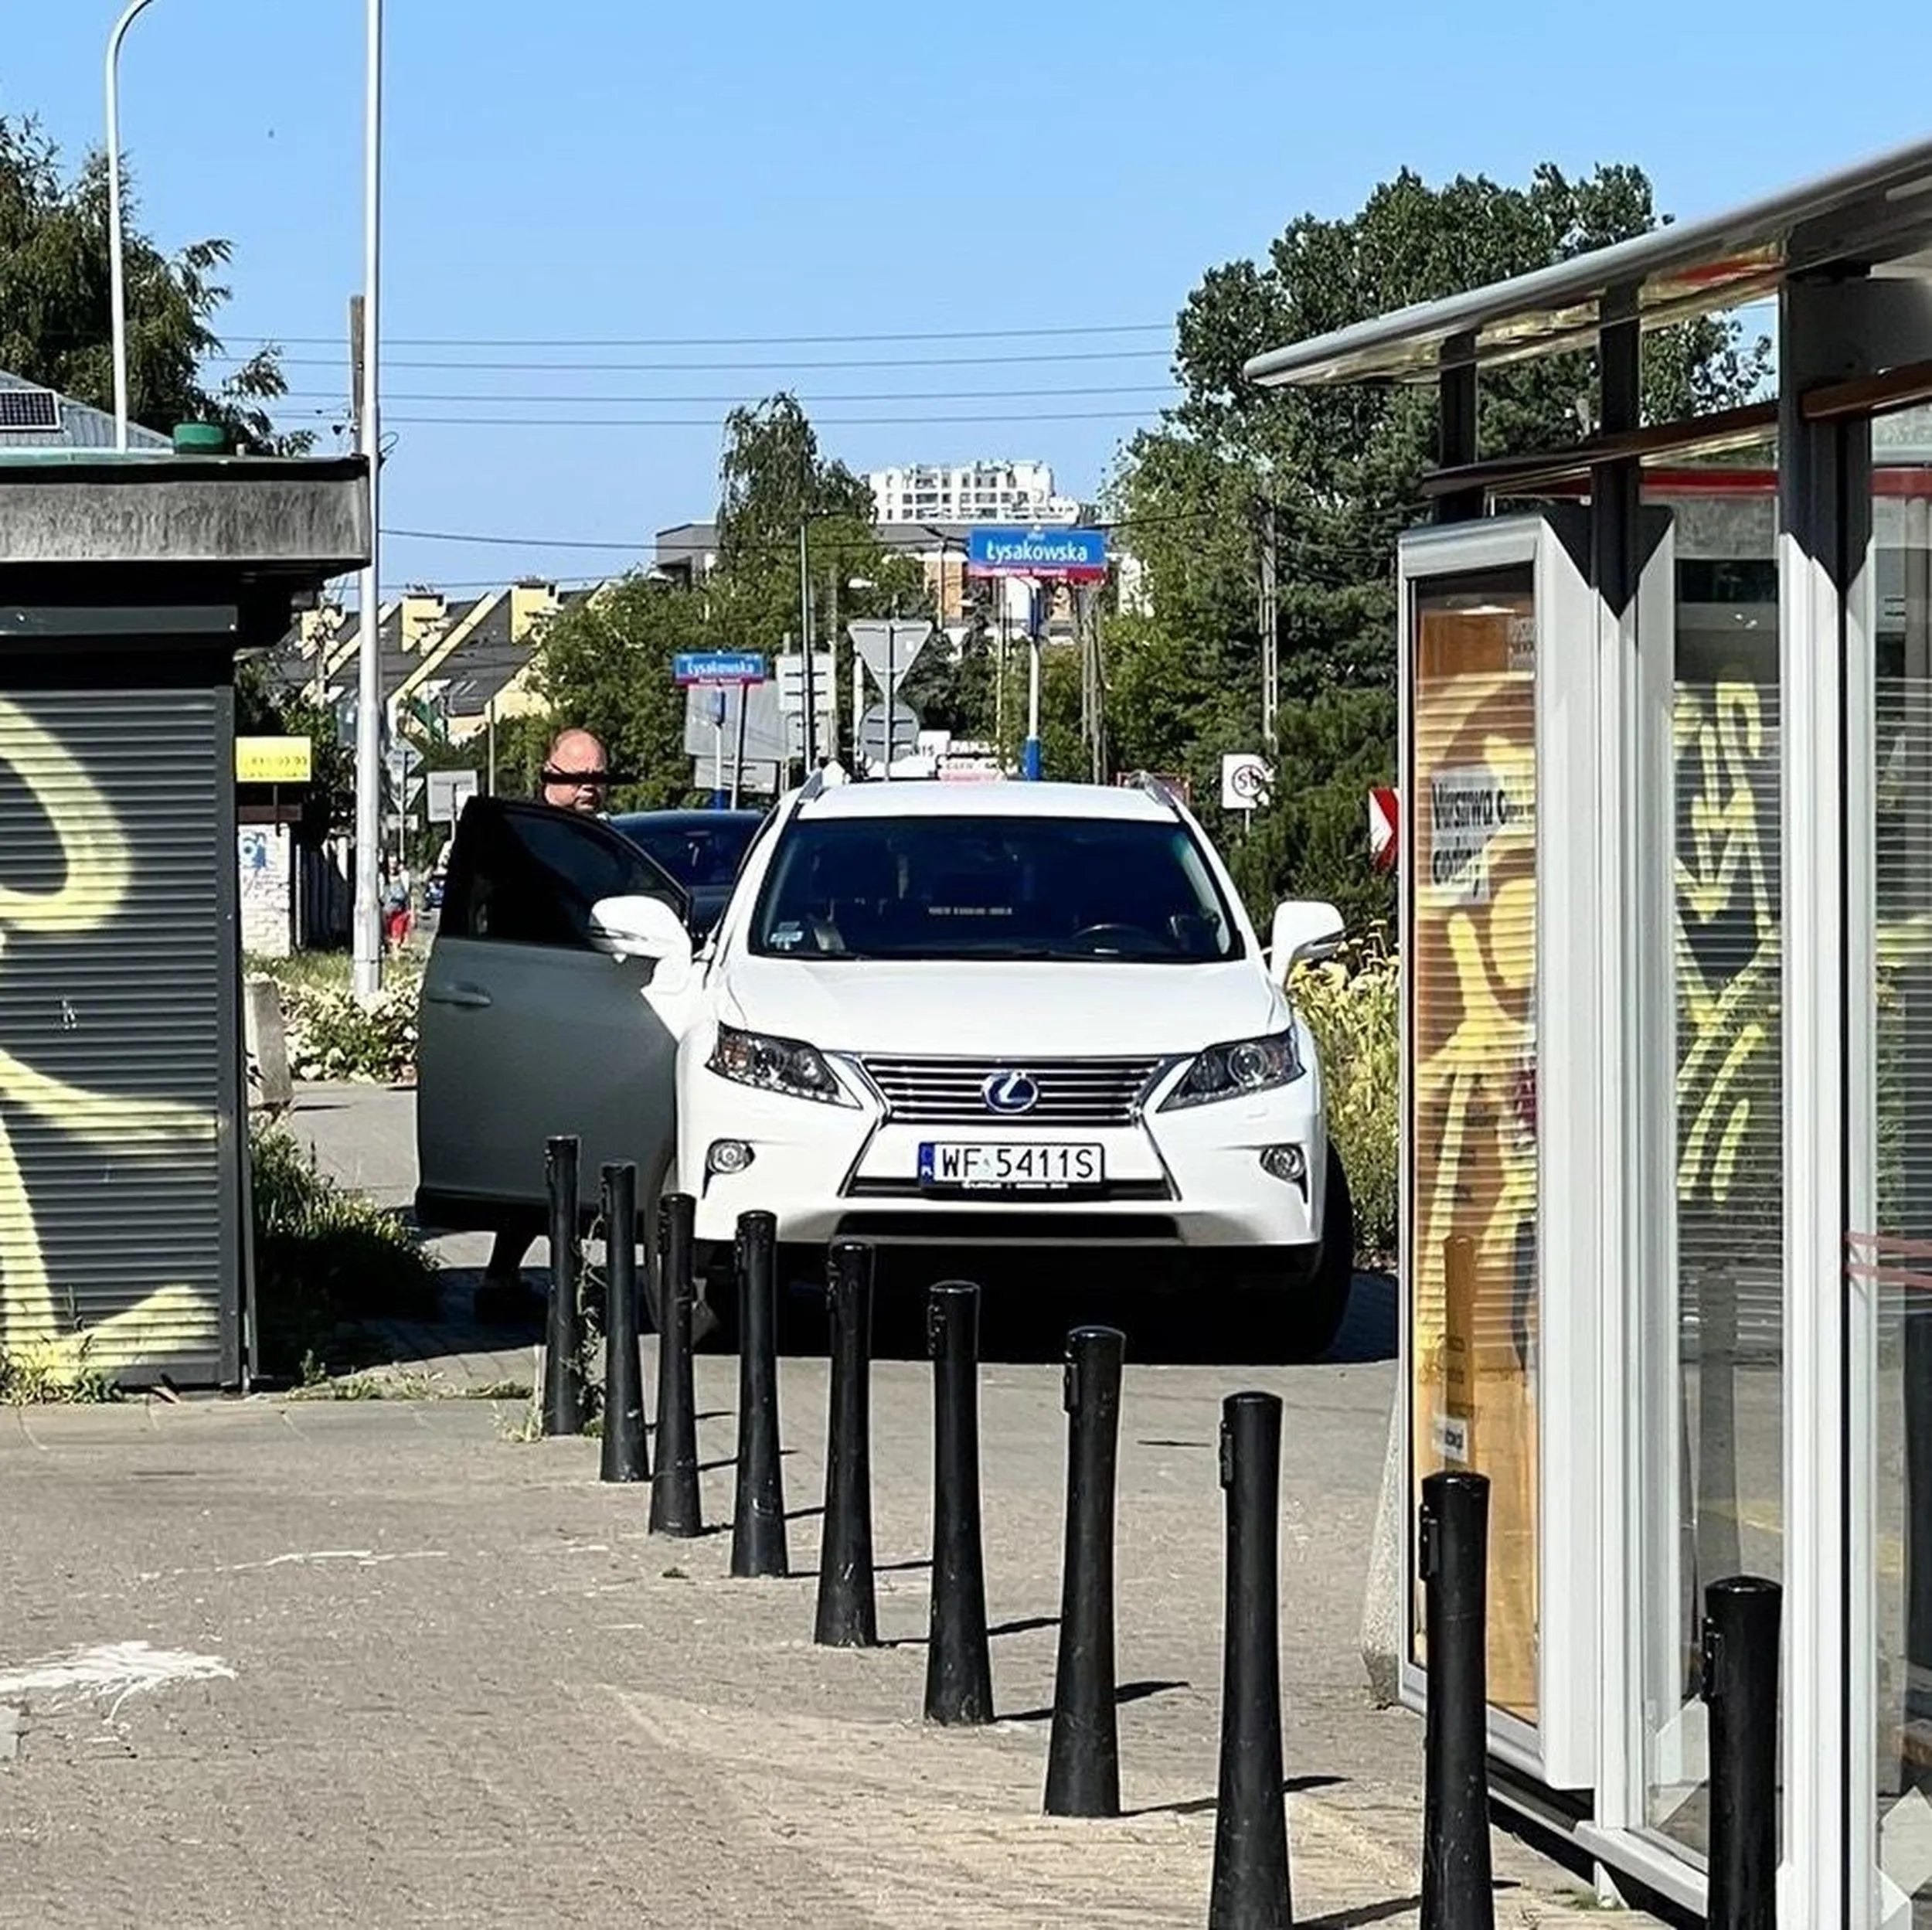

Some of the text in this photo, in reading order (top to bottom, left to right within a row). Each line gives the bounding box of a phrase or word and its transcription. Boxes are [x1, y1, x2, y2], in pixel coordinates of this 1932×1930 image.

[987, 539, 1088, 565] Łysakowska
[943, 1148, 1094, 1178] WF 5411S
